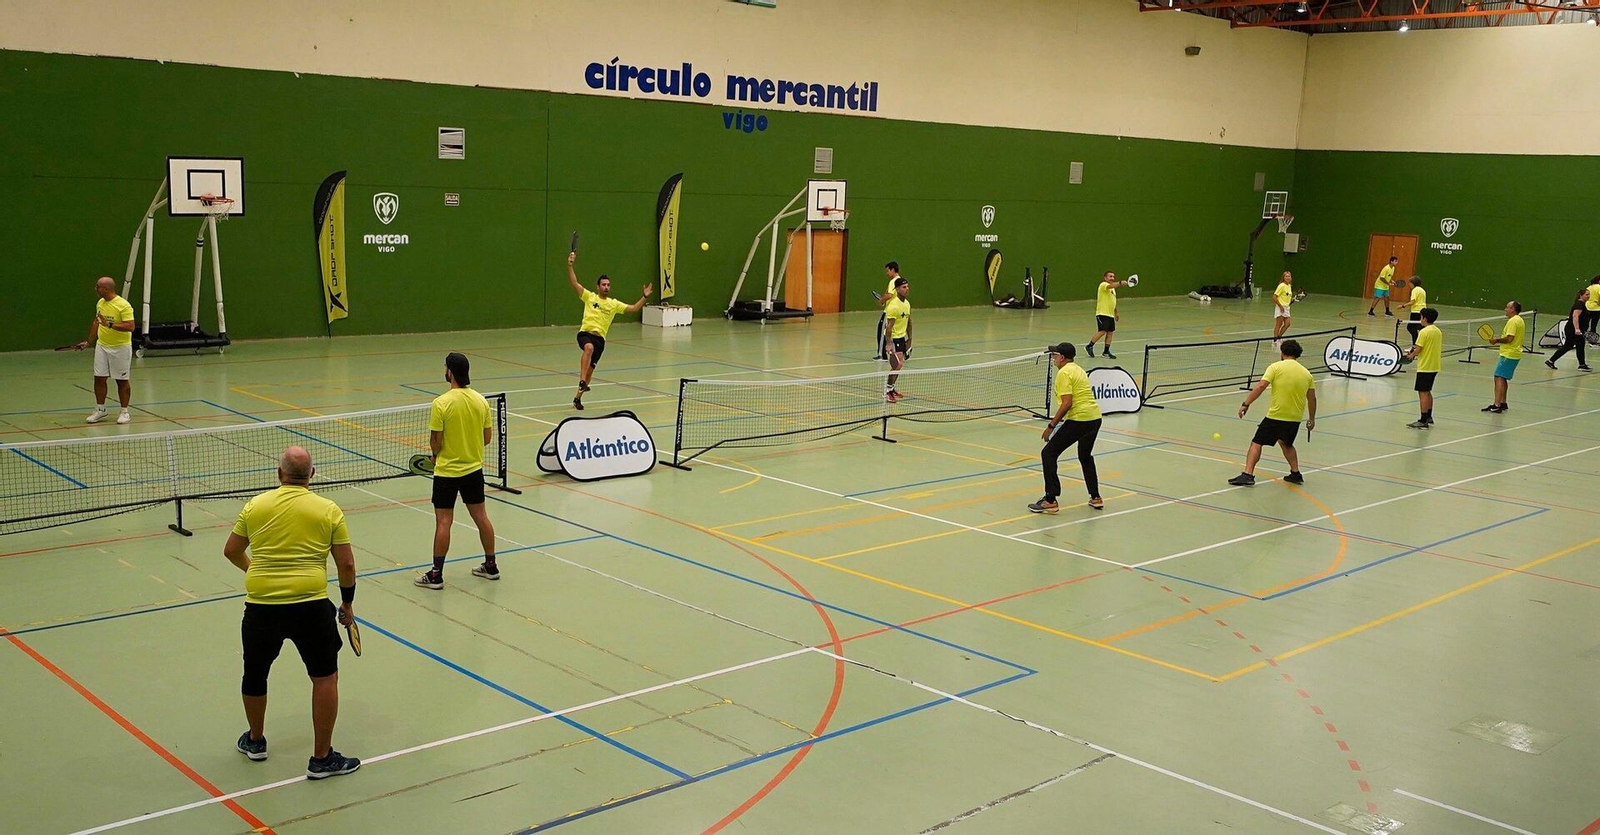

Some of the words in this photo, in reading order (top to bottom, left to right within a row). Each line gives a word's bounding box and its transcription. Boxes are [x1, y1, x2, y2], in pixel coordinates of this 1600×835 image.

[584, 56, 711, 97] círculo
[726, 74, 878, 112] mercantil
[722, 110, 768, 133] vigo
[363, 234, 409, 245] mercan
[974, 234, 998, 242] mercan
[1430, 242, 1462, 250] mercan
[1329, 348, 1394, 366] Atlántico
[565, 435, 650, 461] Atlántico
